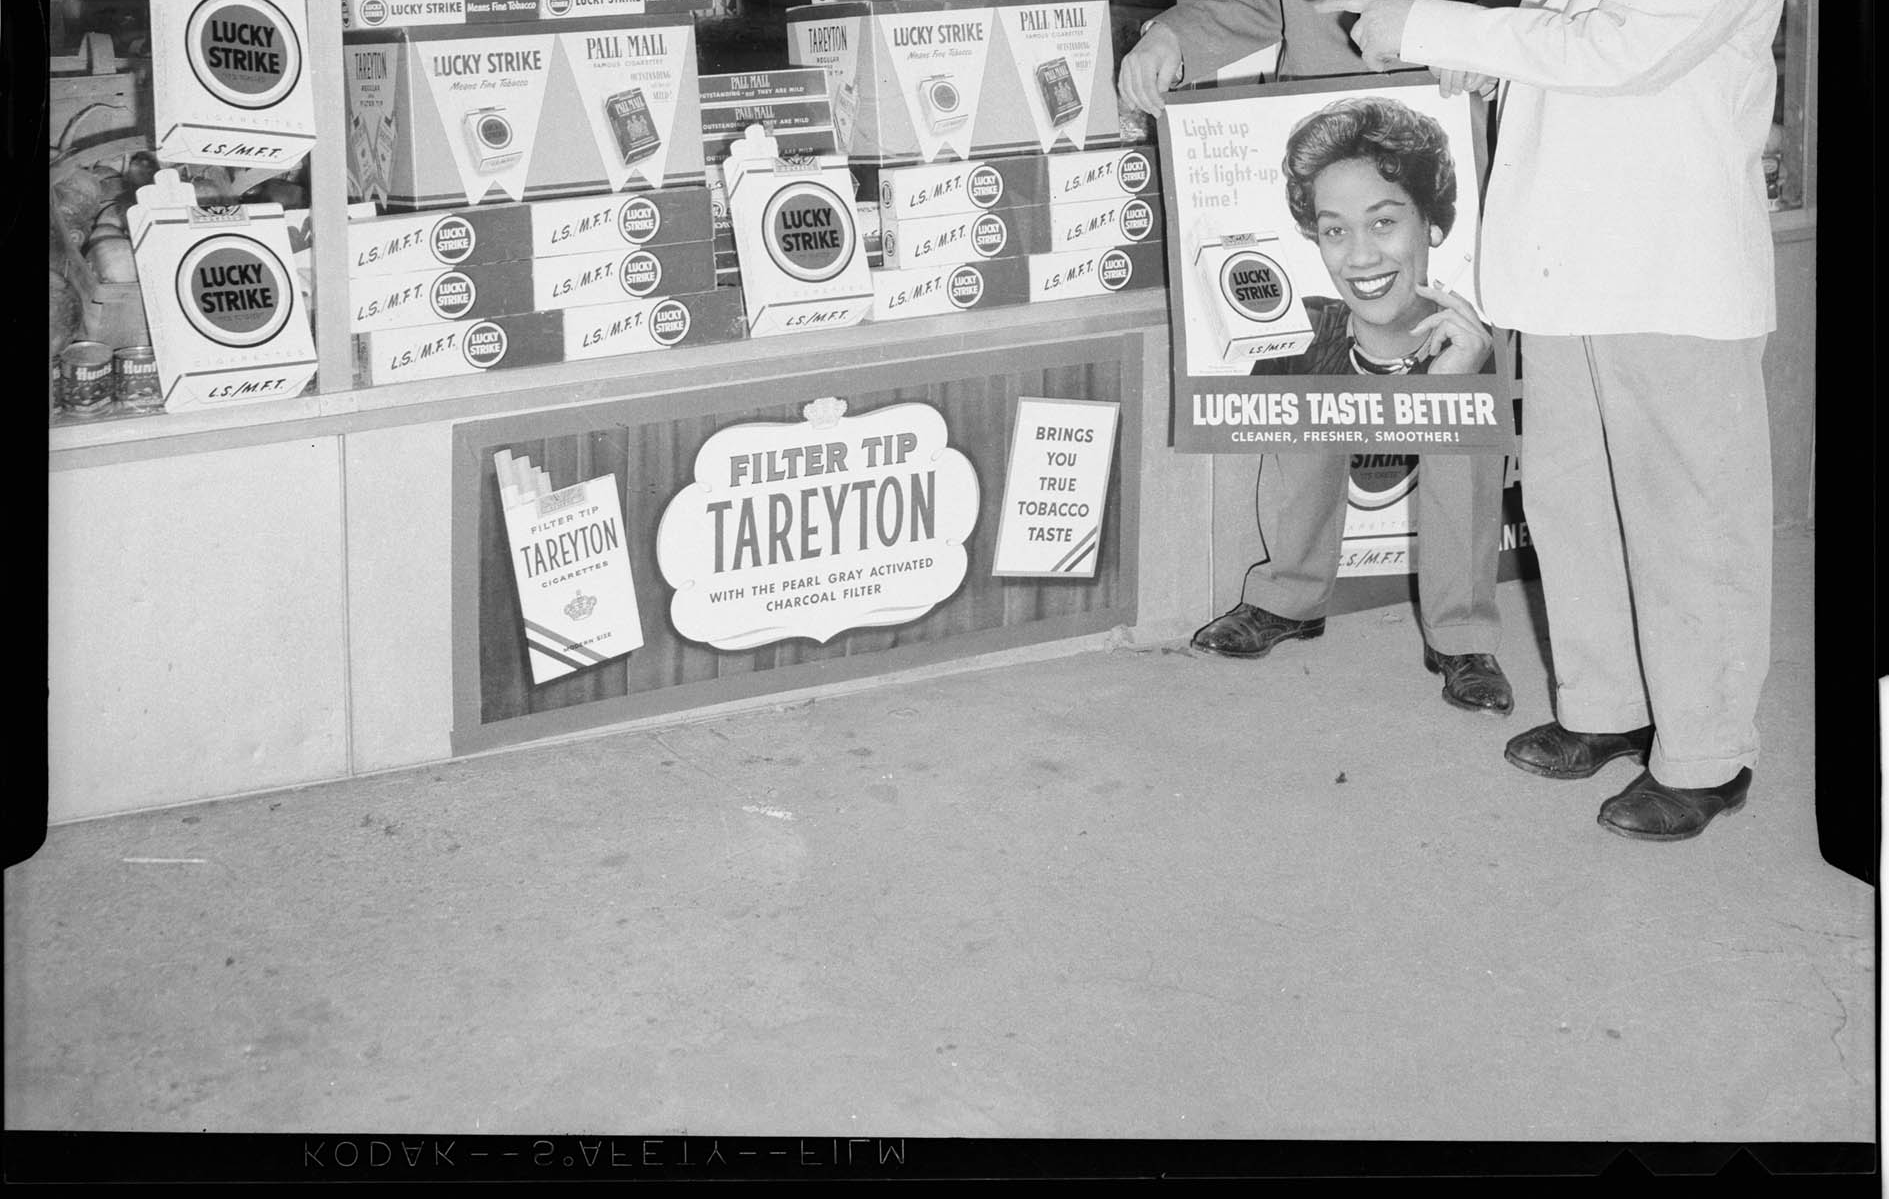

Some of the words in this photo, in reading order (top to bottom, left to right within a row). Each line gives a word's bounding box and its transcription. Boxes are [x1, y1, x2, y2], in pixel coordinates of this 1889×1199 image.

[1020, 9, 1049, 32] PALL
[1054, 7, 1087, 29] MALL
[211, 19, 275, 49] LUCKY
[808, 25, 848, 54] TAREYTON
[893, 25, 933, 47] LUCKY
[937, 22, 984, 44] STRIKE
[587, 35, 622, 60] PALL
[627, 33, 667, 58] MALL
[208, 46, 280, 75] STRIKE
[433, 54, 482, 77] LUCKY
[487, 50, 542, 73] STRIKE
[731, 75, 750, 90] PALL
[1182, 118, 1224, 140] Light
[1229, 122, 1250, 138] up
[1187, 148, 1198, 160] a
[973, 185, 998, 197] STRIKE
[974, 175, 996, 187] LUCKY
[1192, 185, 1239, 208] time!
[781, 207, 833, 230] LUCKY
[439, 227, 467, 239] LUCKY
[781, 229, 841, 253] STRIKE
[438, 238, 470, 252] STRIKE
[200, 262, 263, 289] LUCKY
[1232, 268, 1272, 287] LUCKY
[200, 287, 274, 314] STRIKE
[1235, 284, 1281, 303] STRIKE
[1192, 392, 1299, 426] LUCKIES
[1306, 392, 1385, 425] TASTE
[1394, 391, 1498, 426] BETTER
[1035, 426, 1094, 443] BRINGS
[1231, 431, 1298, 444] CLEANER,
[1303, 430, 1369, 443] FRESHER,
[1375, 431, 1460, 443] SMOOTHER!
[729, 441, 849, 488] FILTER
[861, 432, 918, 468] TIP
[1046, 452, 1077, 467] YOU
[1039, 476, 1077, 492] TRUE
[530, 513, 574, 535] FILTER
[578, 505, 599, 519] TIP
[1017, 501, 1090, 518] TOBACCO
[706, 470, 936, 574] TAREYTON
[1028, 527, 1073, 542] TASTE
[520, 517, 619, 579] TAREYTON
[541, 560, 609, 589] CIGARETTES
[709, 588, 745, 604] WITH
[751, 583, 776, 597] THE
[782, 575, 821, 592] PEARL
[828, 568, 864, 585] GRAY
[869, 557, 934, 578] ACTIVATED
[766, 593, 837, 612] CHARCOAL
[843, 583, 882, 600] FILTER
[596, 631, 613, 641] SIZE
